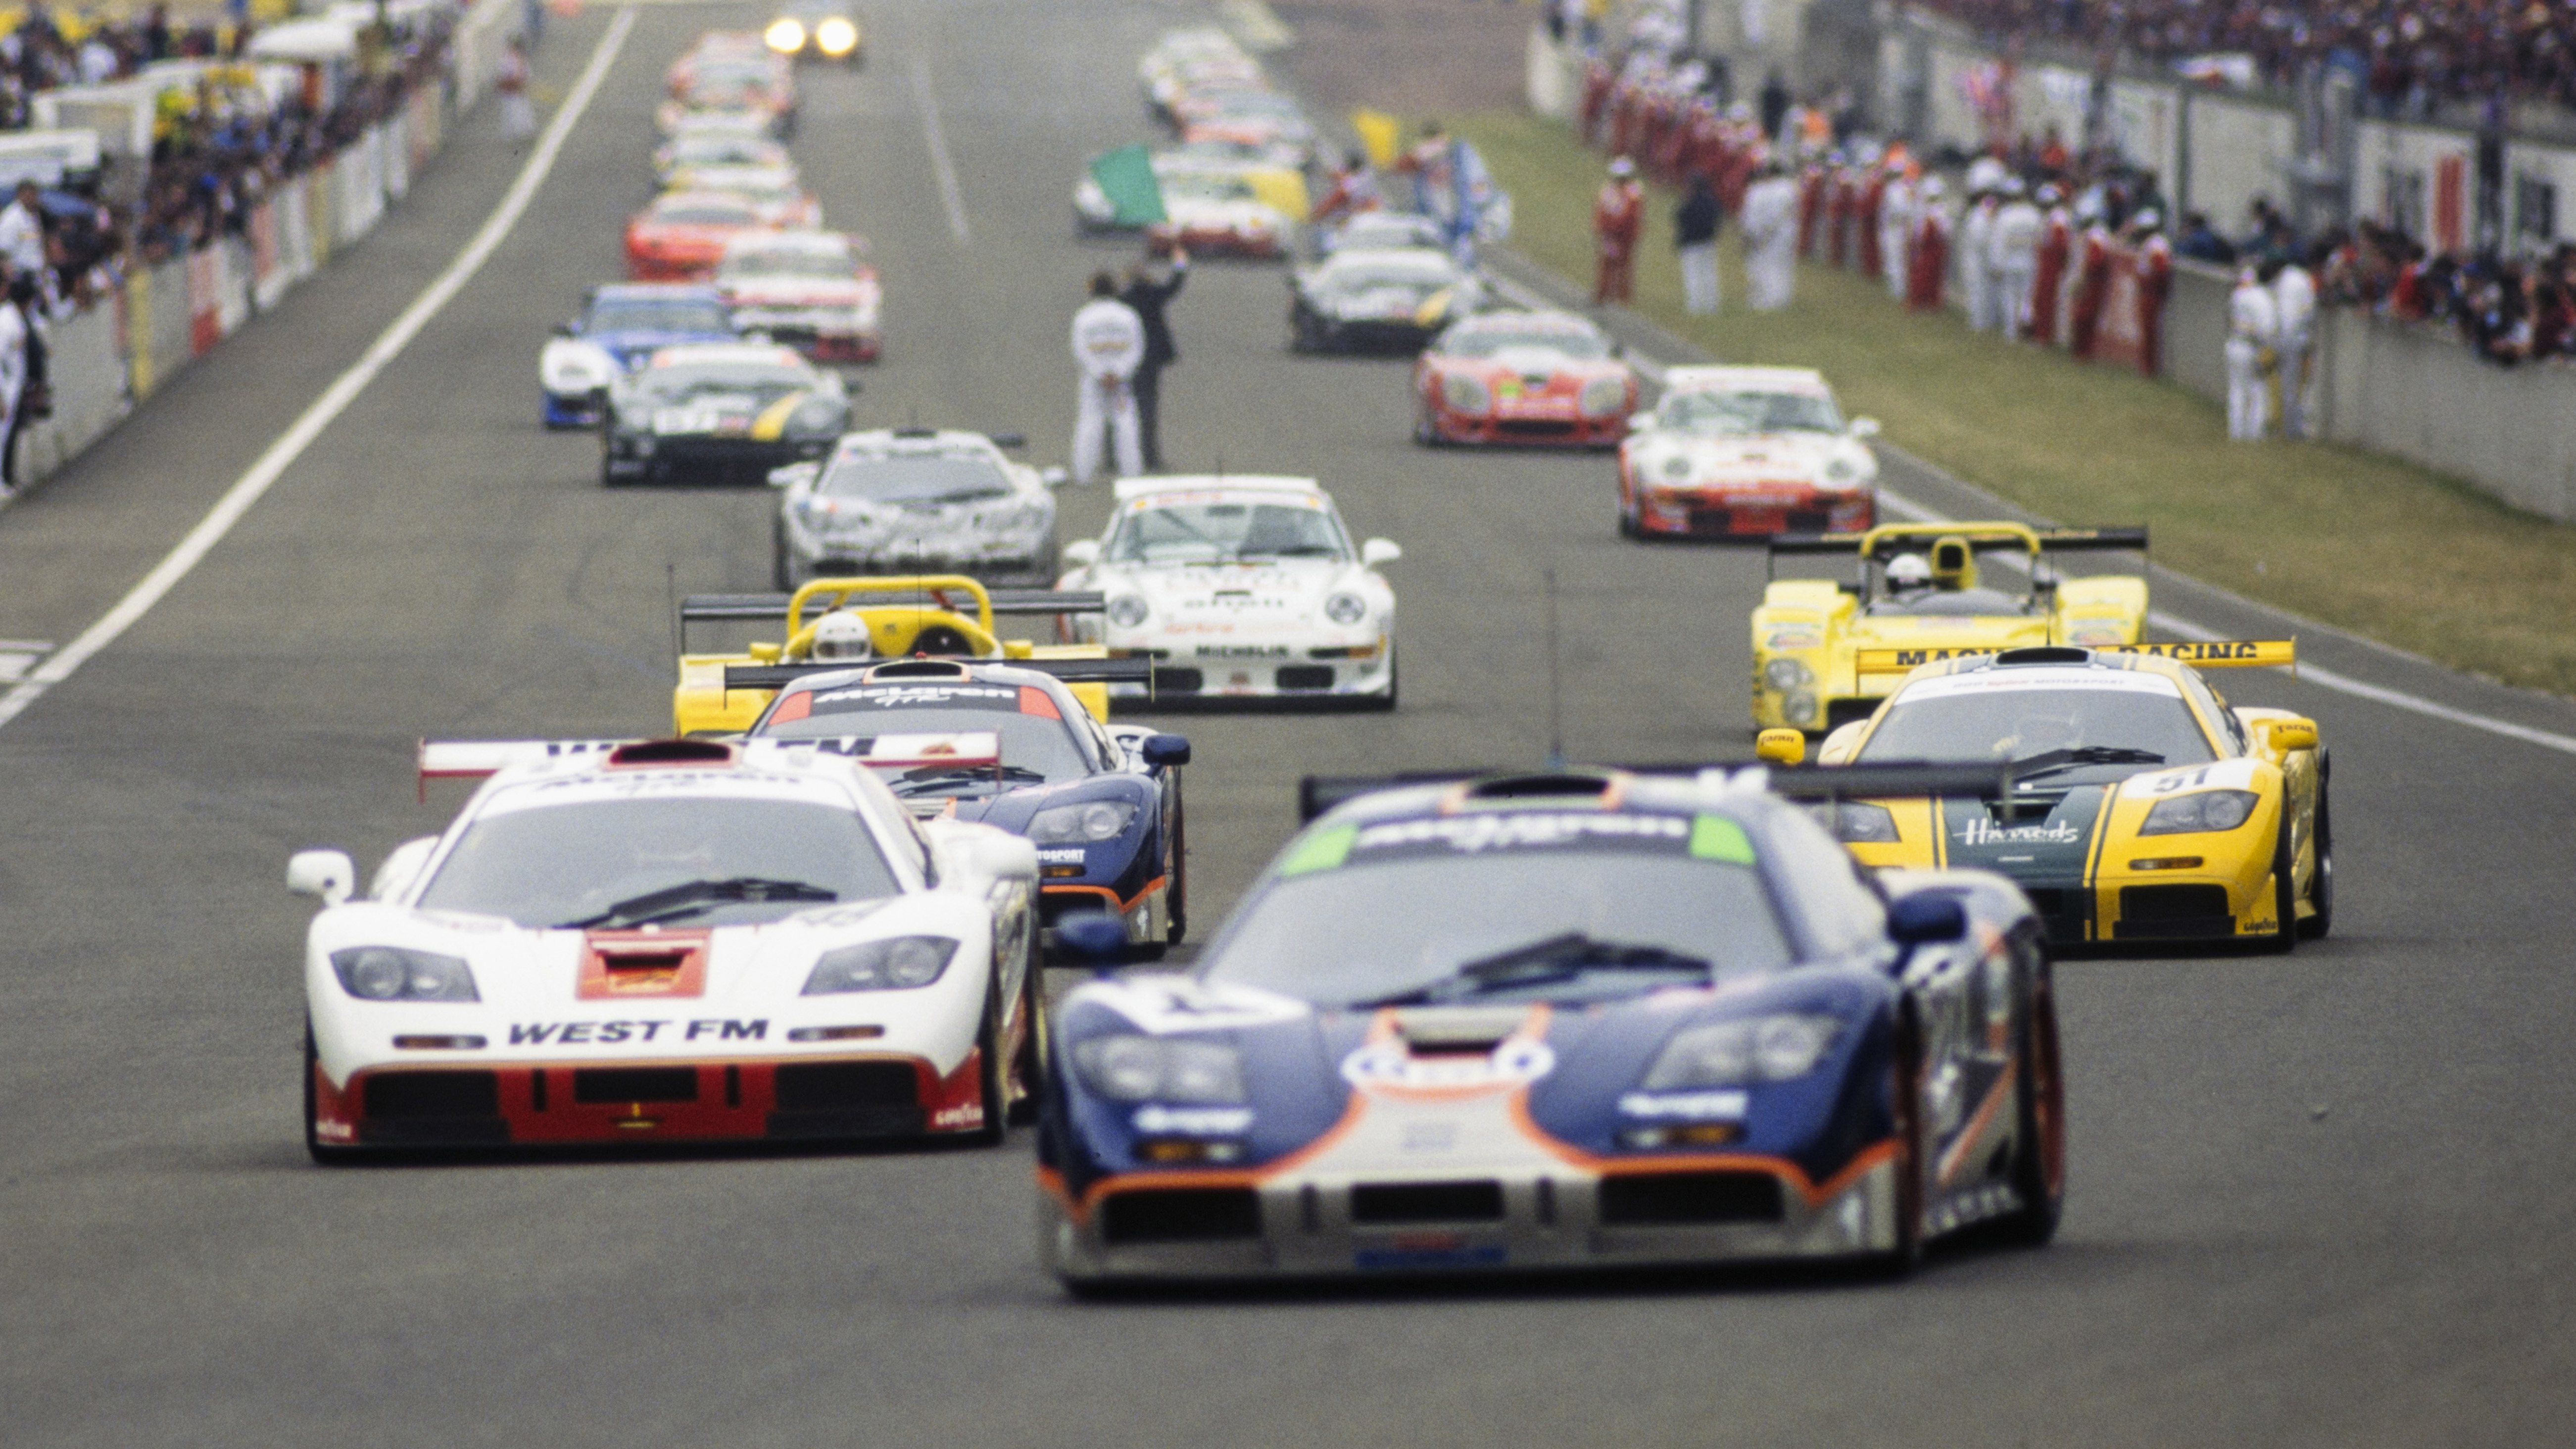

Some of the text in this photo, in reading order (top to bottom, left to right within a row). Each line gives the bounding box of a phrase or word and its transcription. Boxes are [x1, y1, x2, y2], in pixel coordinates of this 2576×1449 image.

[1952, 818, 2078, 845] Harrods
[1036, 849, 1086, 862] TOSPORT
[509, 1019, 769, 1045] WEST FM
